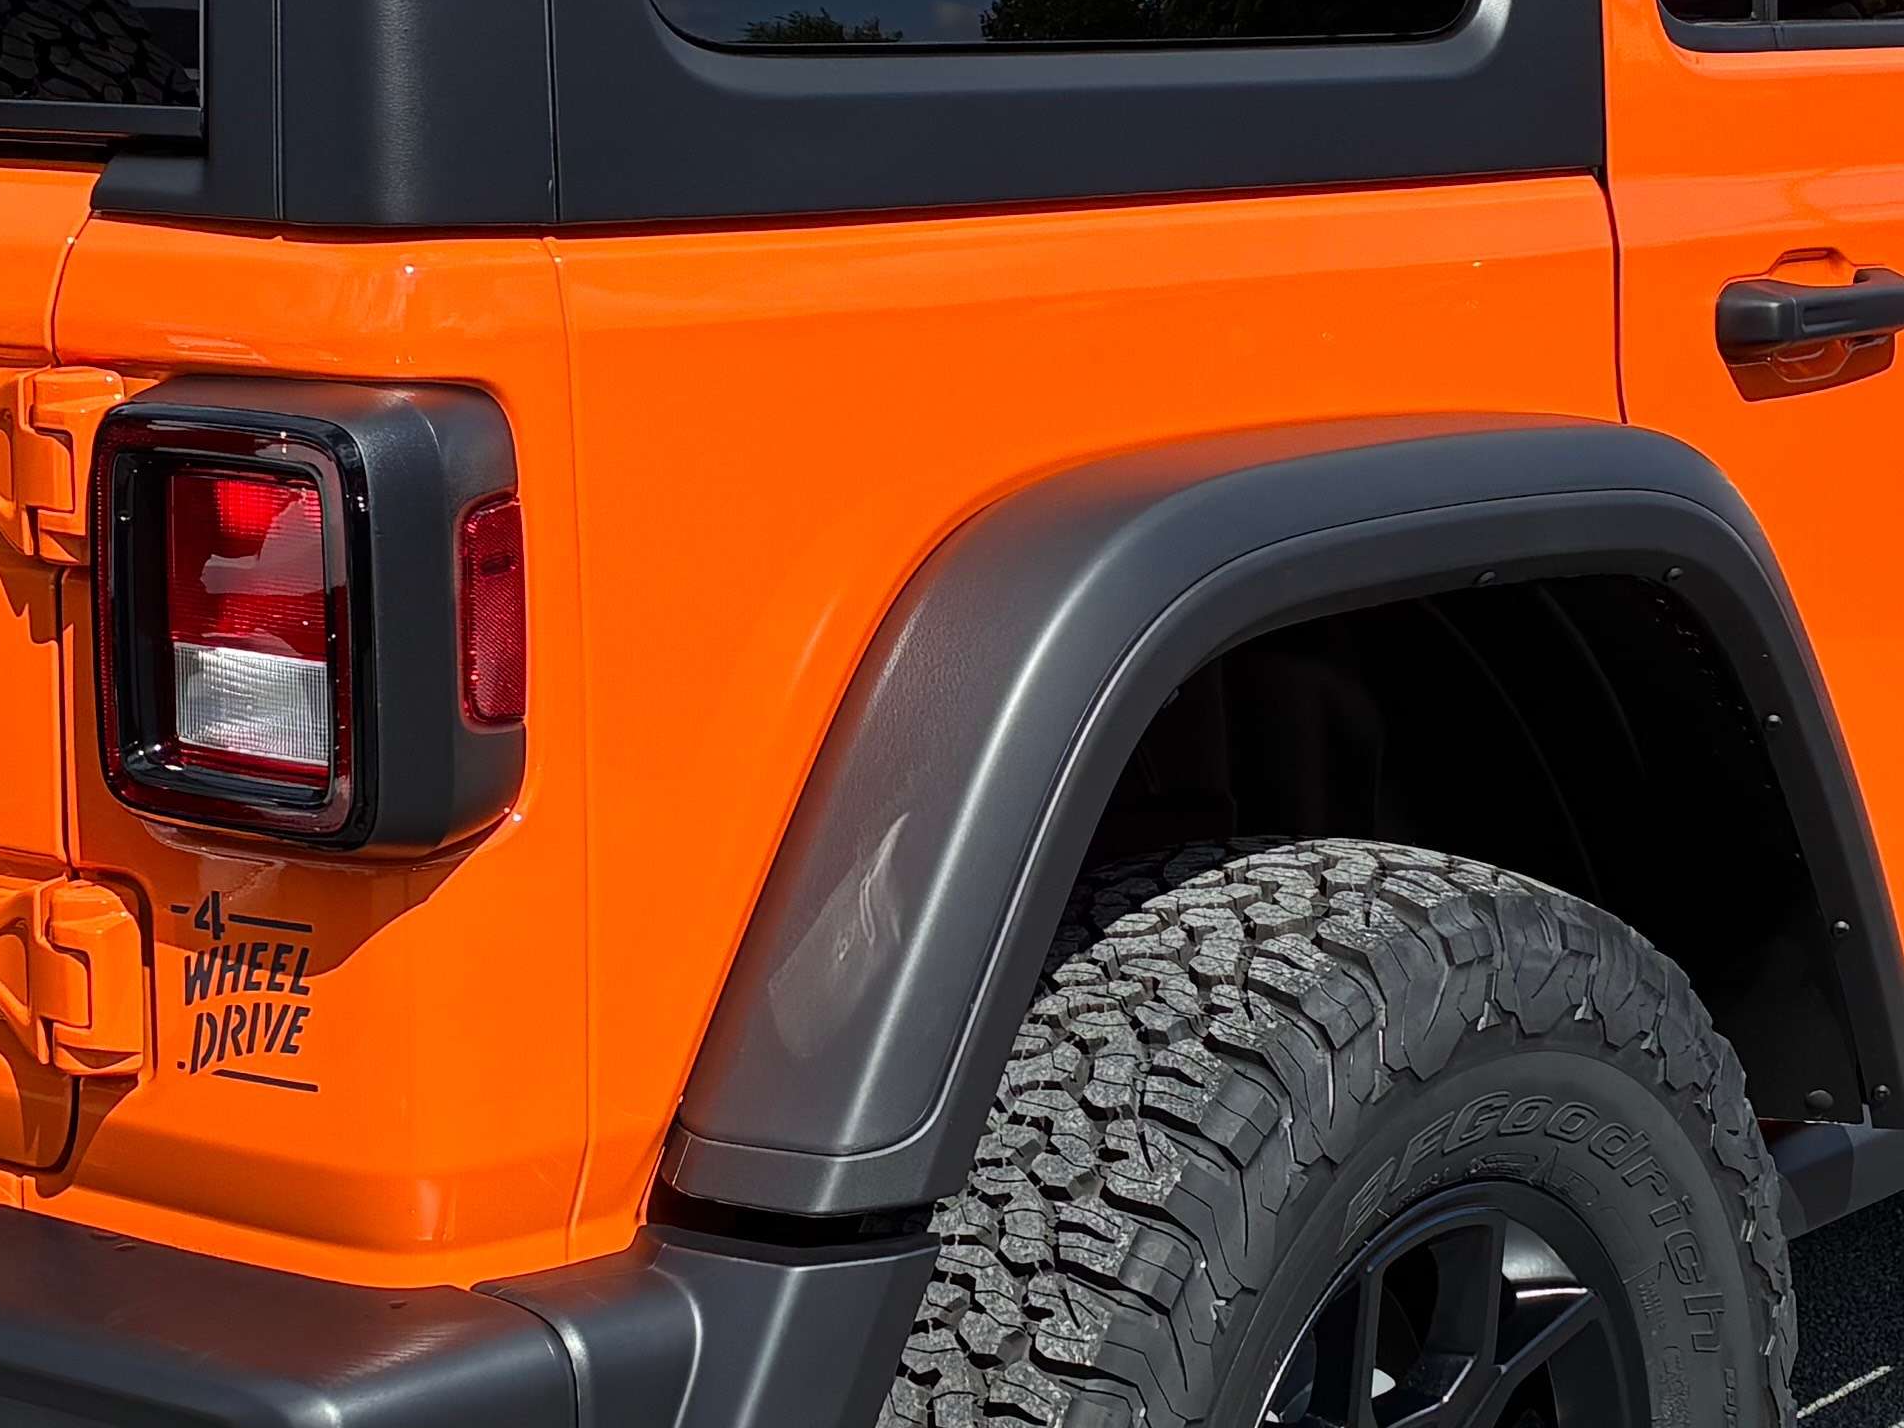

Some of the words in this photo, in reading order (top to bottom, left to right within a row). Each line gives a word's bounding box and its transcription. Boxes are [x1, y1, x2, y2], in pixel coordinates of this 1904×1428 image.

[184, 942, 310, 1006] WHEEL
[189, 1004, 313, 1075] DRIVE
[1336, 1090, 1727, 1354] BFGoodrich
